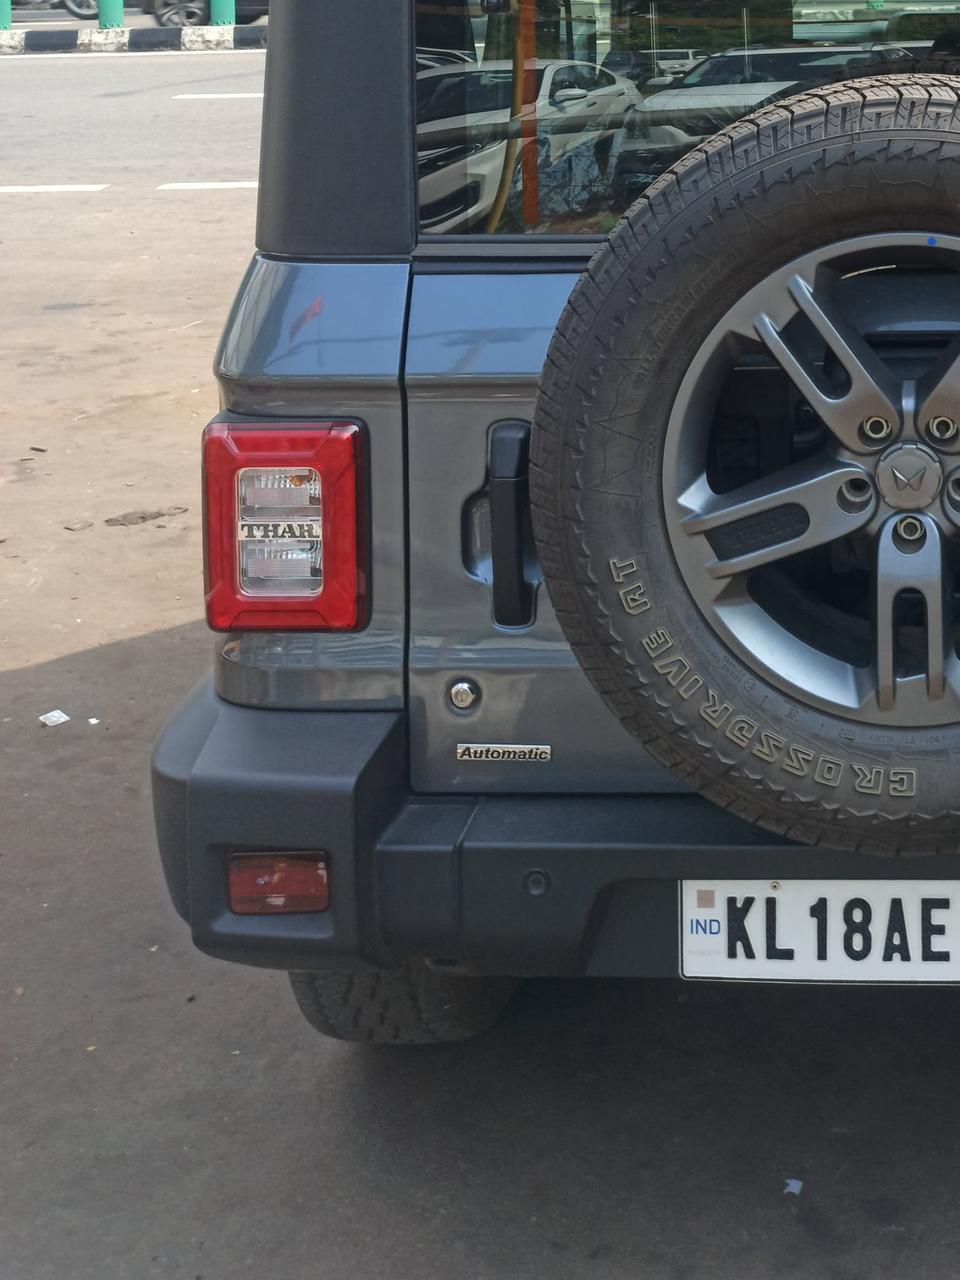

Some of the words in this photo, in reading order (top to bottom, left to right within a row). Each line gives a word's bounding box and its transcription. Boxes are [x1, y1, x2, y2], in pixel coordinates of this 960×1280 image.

[240, 522, 321, 540] THAR
[639, 625, 918, 799] CROSSDRIVE
[459, 746, 549, 761] Automatic
[689, 918, 721, 935] IND
